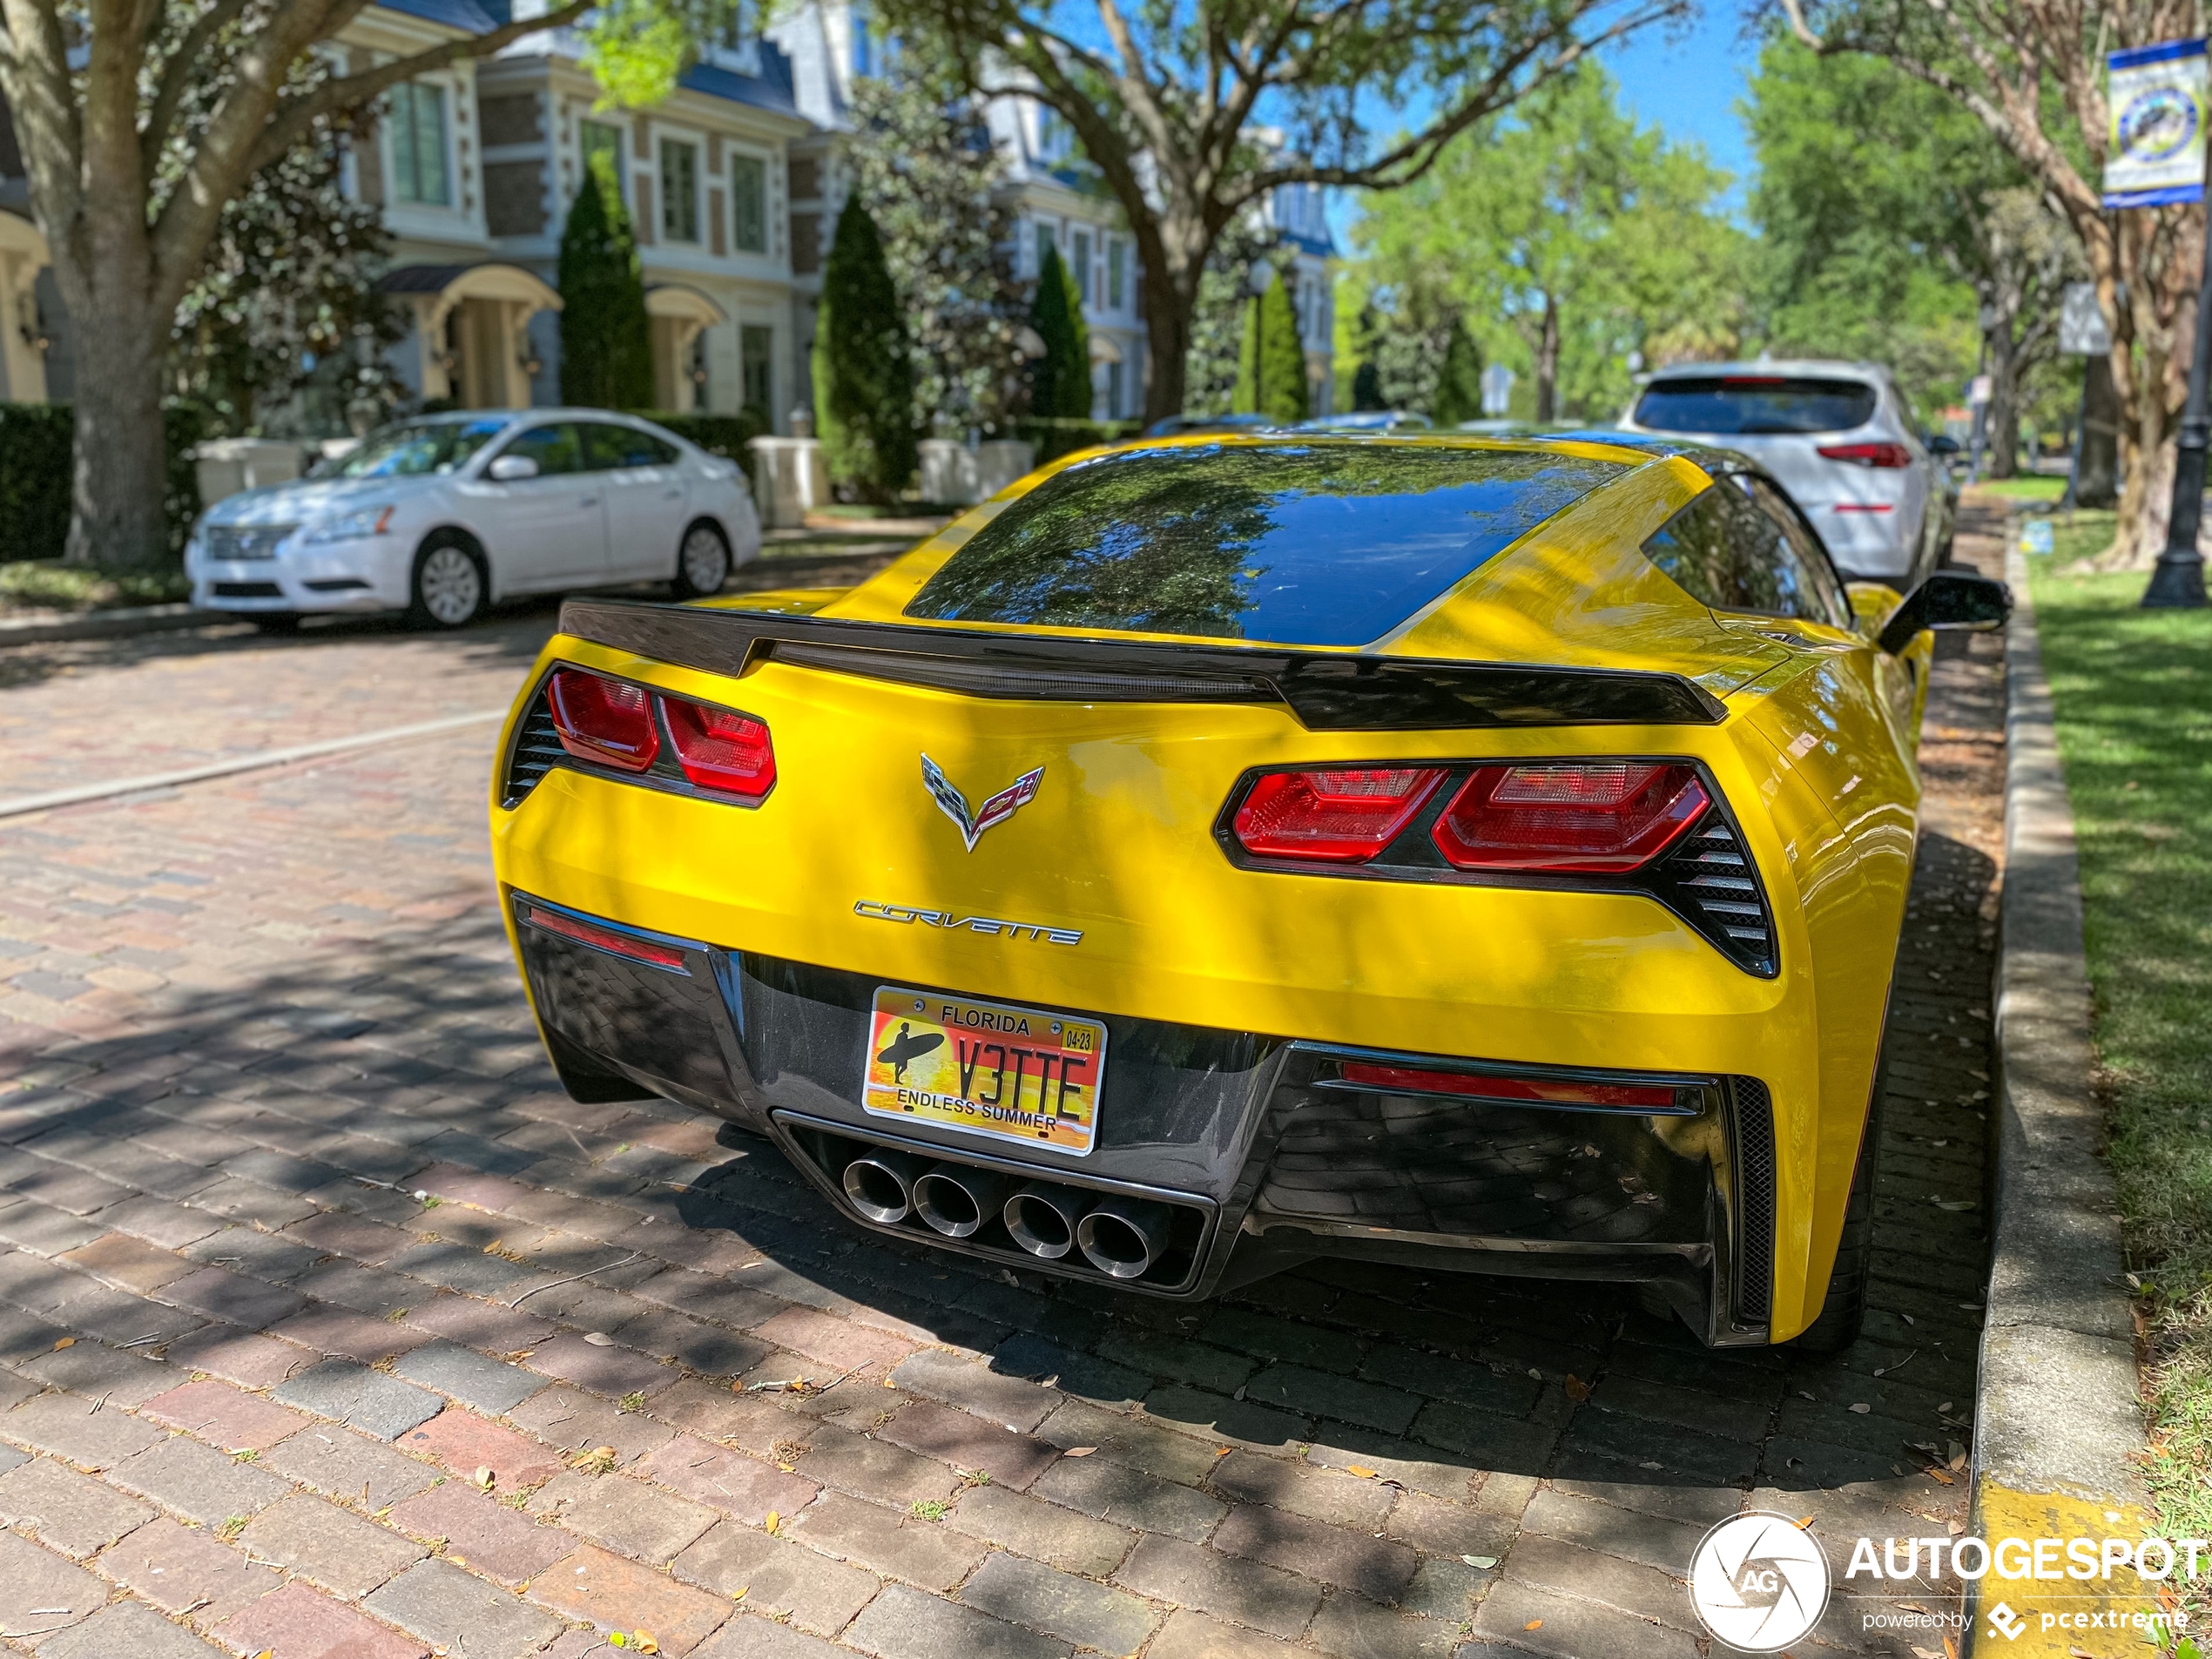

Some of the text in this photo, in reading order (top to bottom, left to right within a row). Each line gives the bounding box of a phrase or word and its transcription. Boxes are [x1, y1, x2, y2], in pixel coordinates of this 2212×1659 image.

[853, 900, 1084, 945] CORVETTE
[941, 1004, 1031, 1036] FLORIDA
[959, 1037, 1088, 1122] V3TTE
[897, 1089, 1056, 1132] ENDLESS SUMMER
